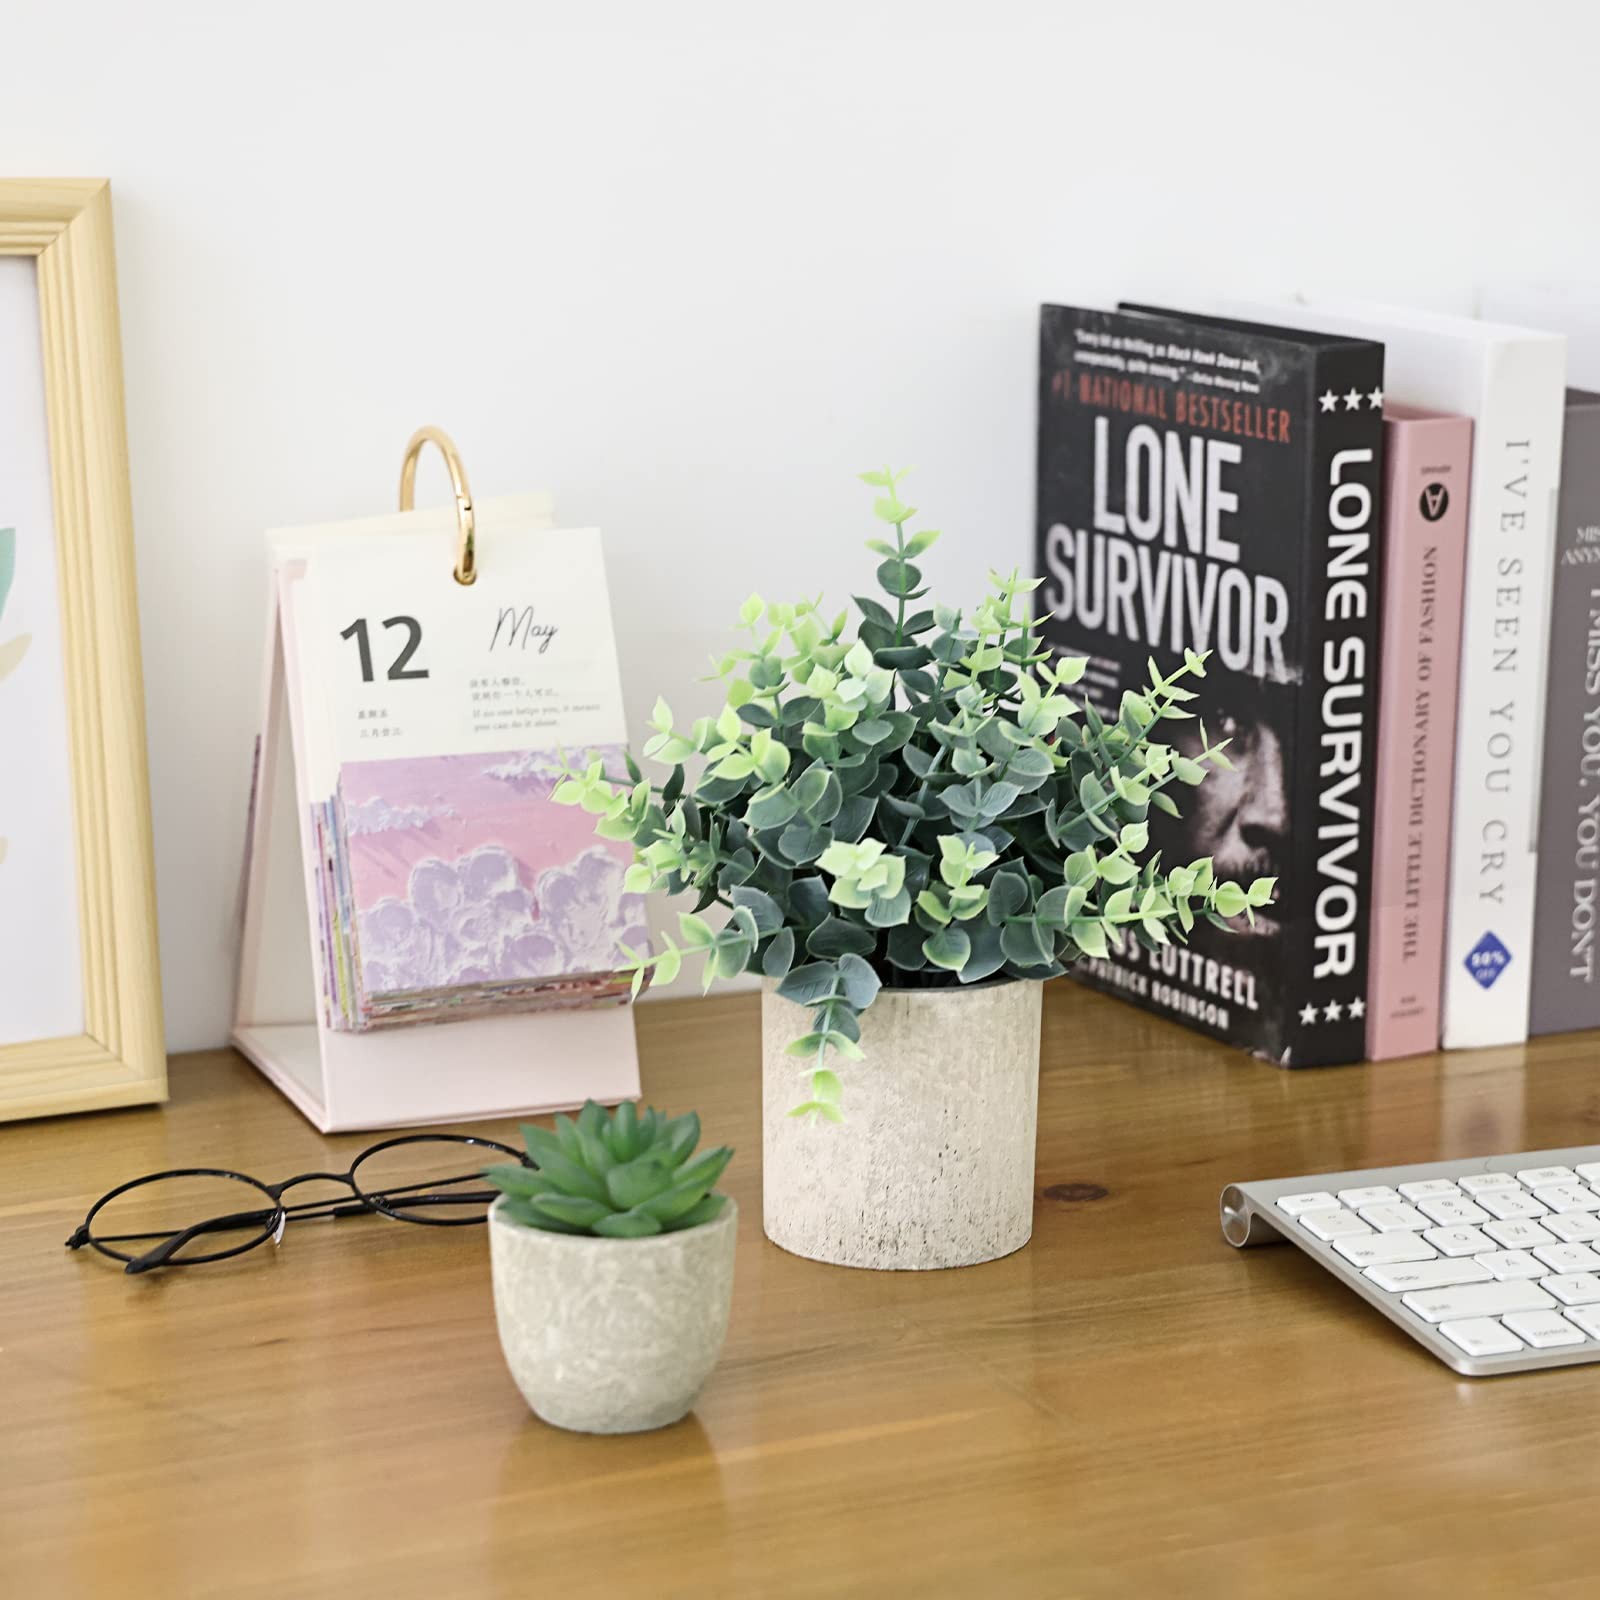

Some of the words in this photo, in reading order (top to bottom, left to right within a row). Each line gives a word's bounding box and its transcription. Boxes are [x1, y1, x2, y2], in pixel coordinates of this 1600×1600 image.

[1079, 373, 1168, 420] NATIONAL
[1175, 390, 1291, 444] BESTSELLER
[1094, 416, 1242, 563] LONE
[1500, 440, 1530, 533] I'VE
[1324, 447, 1374, 621] LONE
[489, 605, 559, 654] May
[1044, 523, 1290, 684] SURVIVOR
[1418, 546, 1438, 645] FASHION
[1493, 557, 1523, 672] SEEN
[340, 615, 430, 683] 12
[1417, 651, 1433, 682] OF
[1408, 689, 1430, 826] DICTIONARY
[1485, 701, 1515, 792] YOU
[1312, 635, 1366, 980] SURVIVOR
[1575, 795, 1600, 870] YOU
[1404, 832, 1422, 909] LITTLE
[1479, 819, 1506, 903] CRY
[1149, 944, 1259, 1010] LUTTRELL
[1403, 914, 1419, 964] THE
[1088, 957, 1148, 996] PATRICK
[1152, 981, 1230, 1030] ROBINSON
